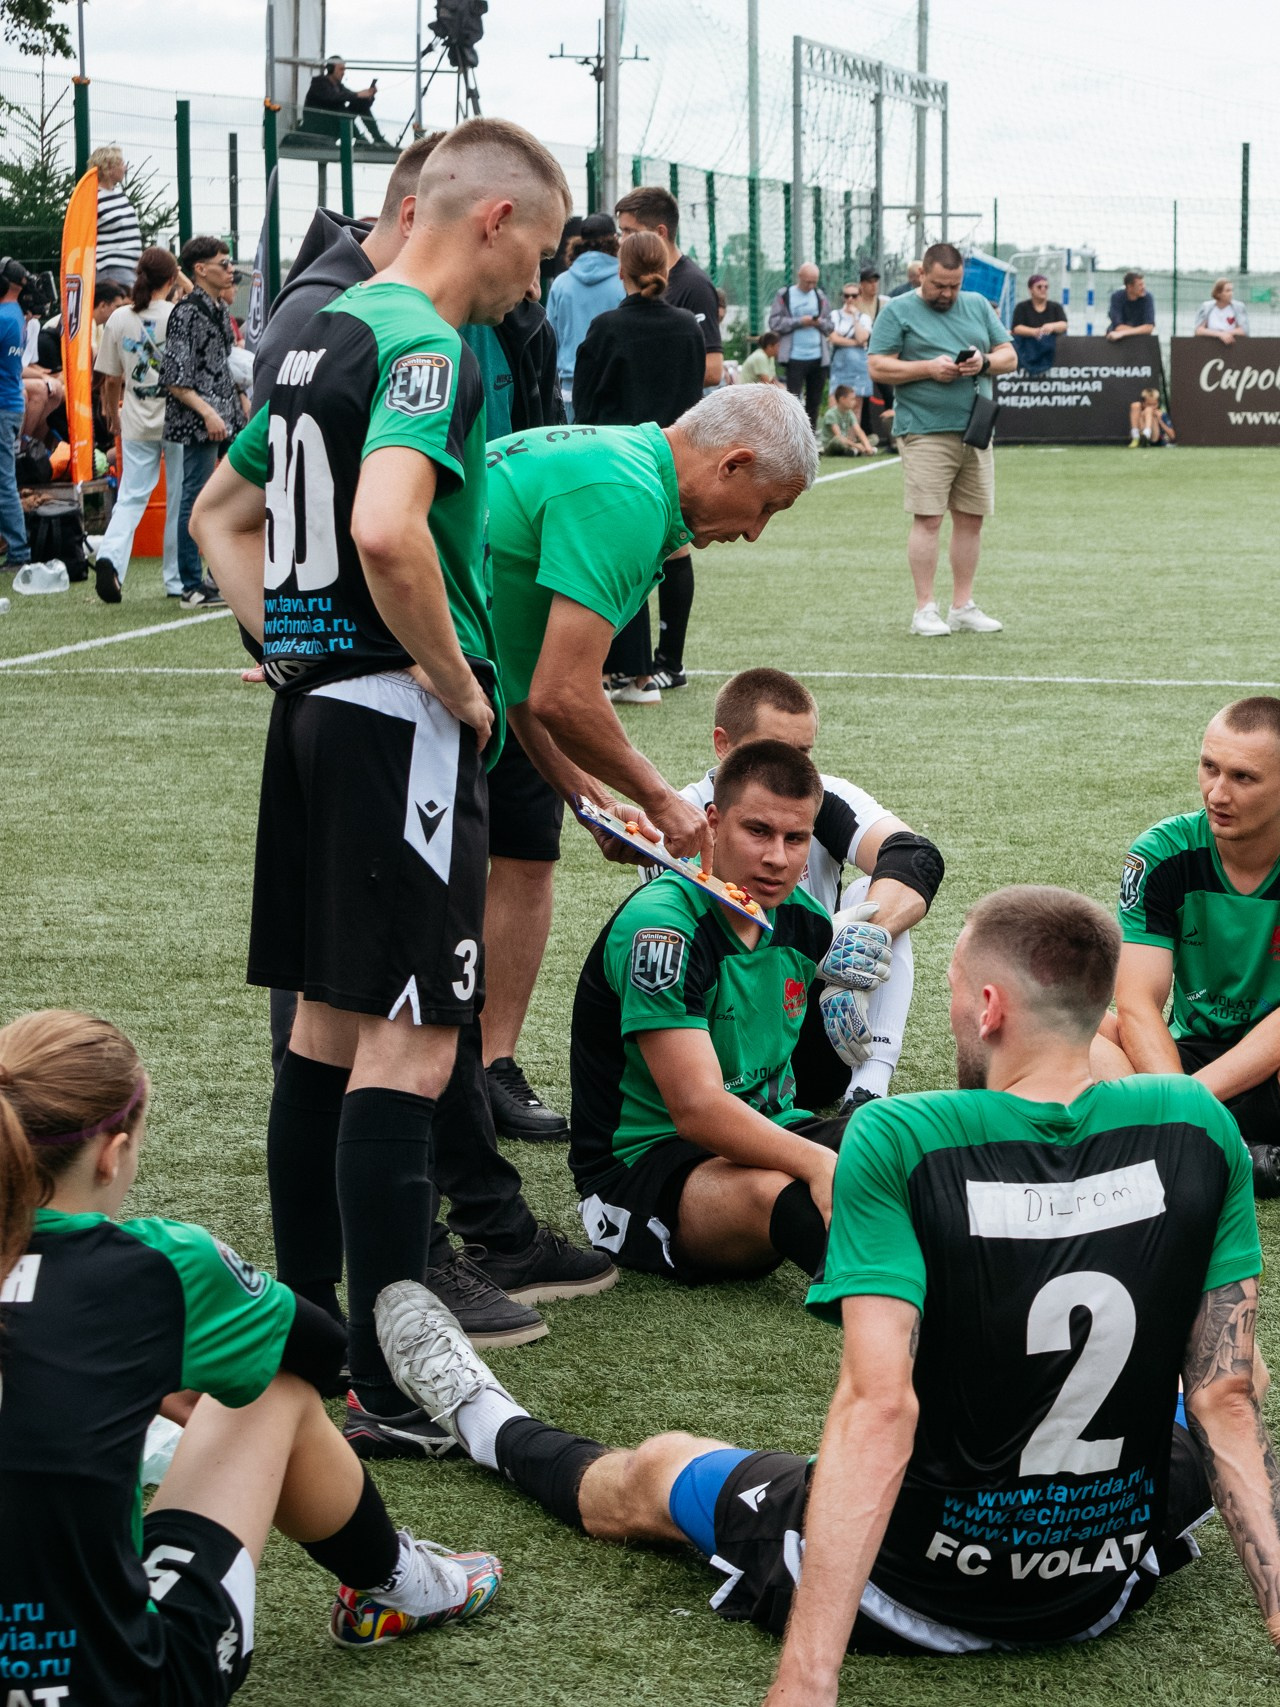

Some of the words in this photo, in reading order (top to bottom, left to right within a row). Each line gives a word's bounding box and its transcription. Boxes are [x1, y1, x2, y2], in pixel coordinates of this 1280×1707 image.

[997, 381, 1103, 393] ФУТБОЛЬНАЯ
[997, 394, 1092, 409] МЕДИАЛИГА
[451, 938, 478, 1001] 3
[634, 941, 675, 985] EML
[1208, 994, 1256, 1011] VOLAT
[1208, 1007, 1251, 1022] AUTO
[1023, 1186, 1133, 1223] Di_rom
[1018, 1271, 1137, 1478] 2
[944, 1477, 1155, 1524] www.technoavia.ru
[976, 1466, 1146, 1507] www.tavrida.ru
[941, 1503, 1151, 1546] www.volat-auto.ru
[925, 1531, 992, 1576] FC
[1010, 1530, 1148, 1580] VOLAT
